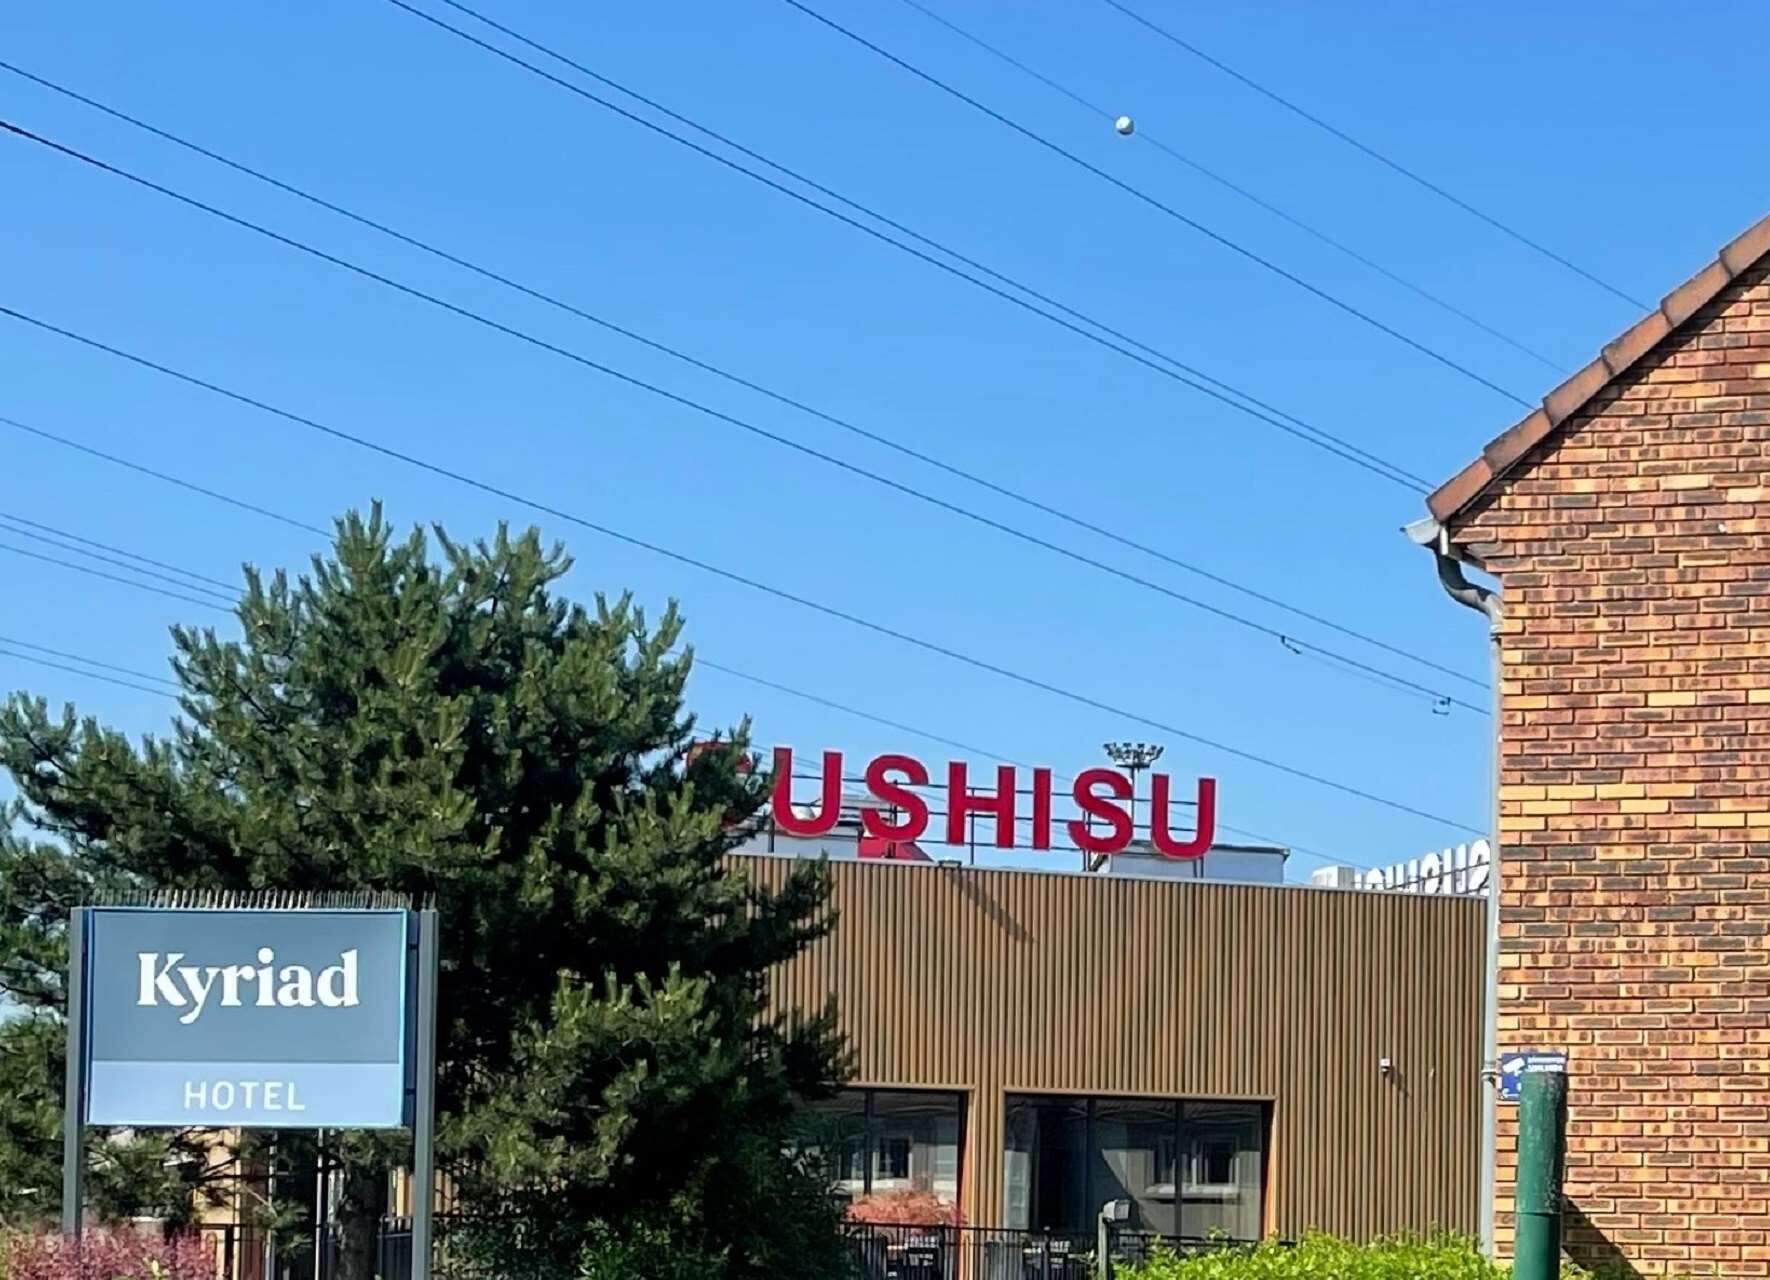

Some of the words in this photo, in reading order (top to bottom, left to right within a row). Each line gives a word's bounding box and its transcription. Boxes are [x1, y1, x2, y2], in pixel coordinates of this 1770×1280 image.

[687, 741, 1217, 860] USHISU
[137, 947, 360, 1024] Kyriad
[184, 1081, 306, 1111] HOTEL
